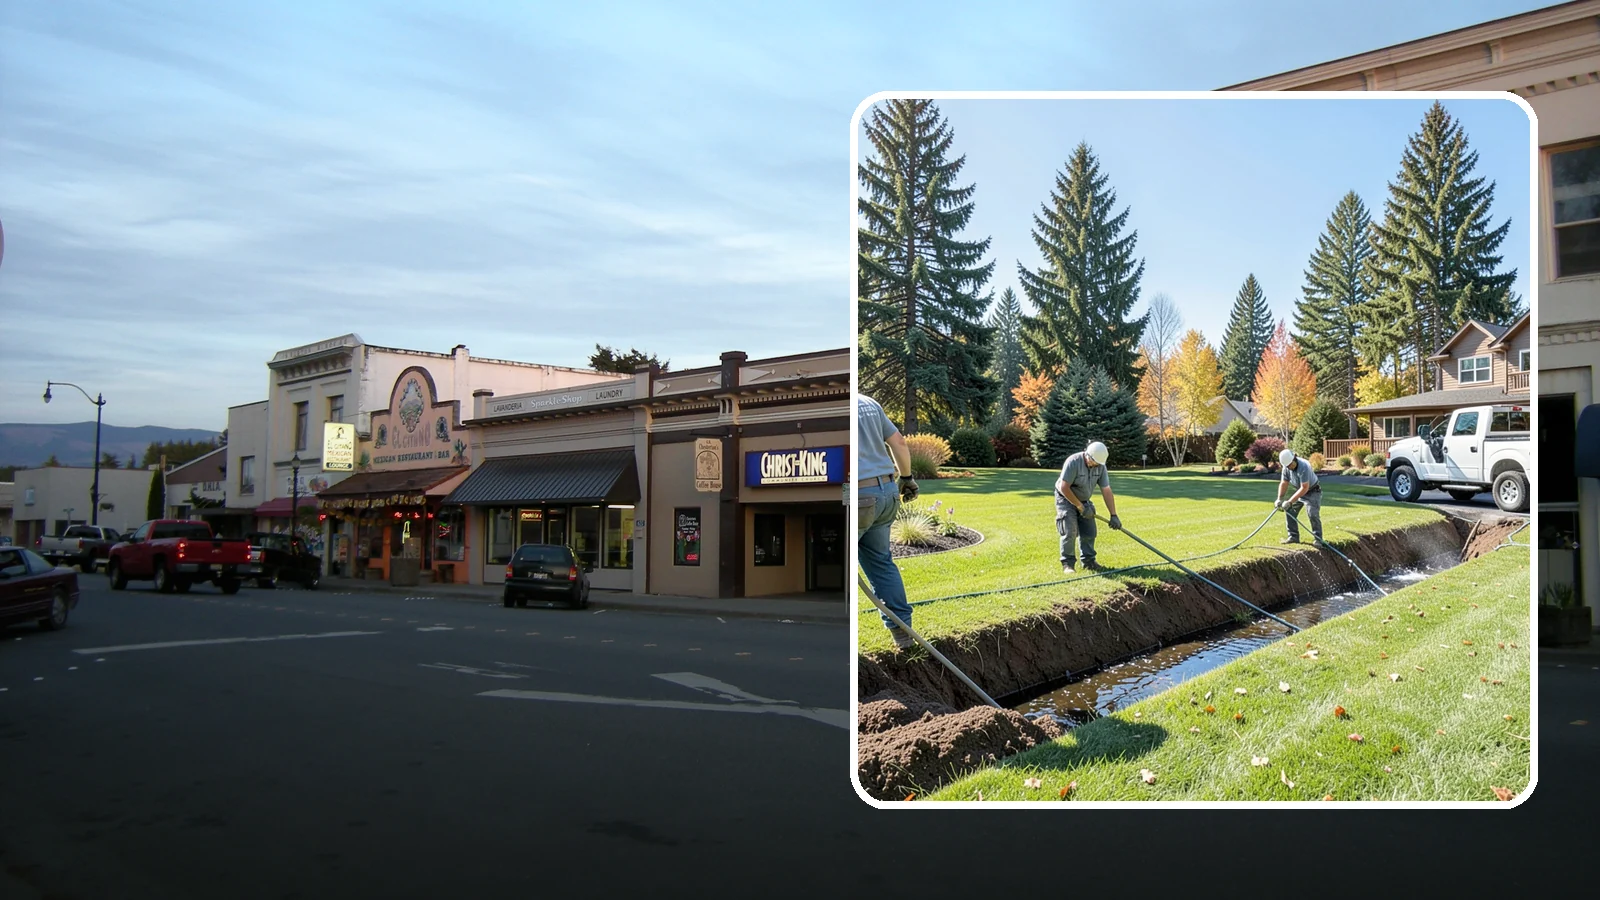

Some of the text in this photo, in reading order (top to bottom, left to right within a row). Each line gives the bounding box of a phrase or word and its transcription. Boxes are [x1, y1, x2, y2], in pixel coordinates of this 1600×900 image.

[595, 389, 623, 400] LAUNDRY
[493, 402, 522, 412] LAVANDERIA
[373, 450, 450, 464] MEXICAN RESTAURANT BAR
[761, 449, 827, 478] CHRIST KING
